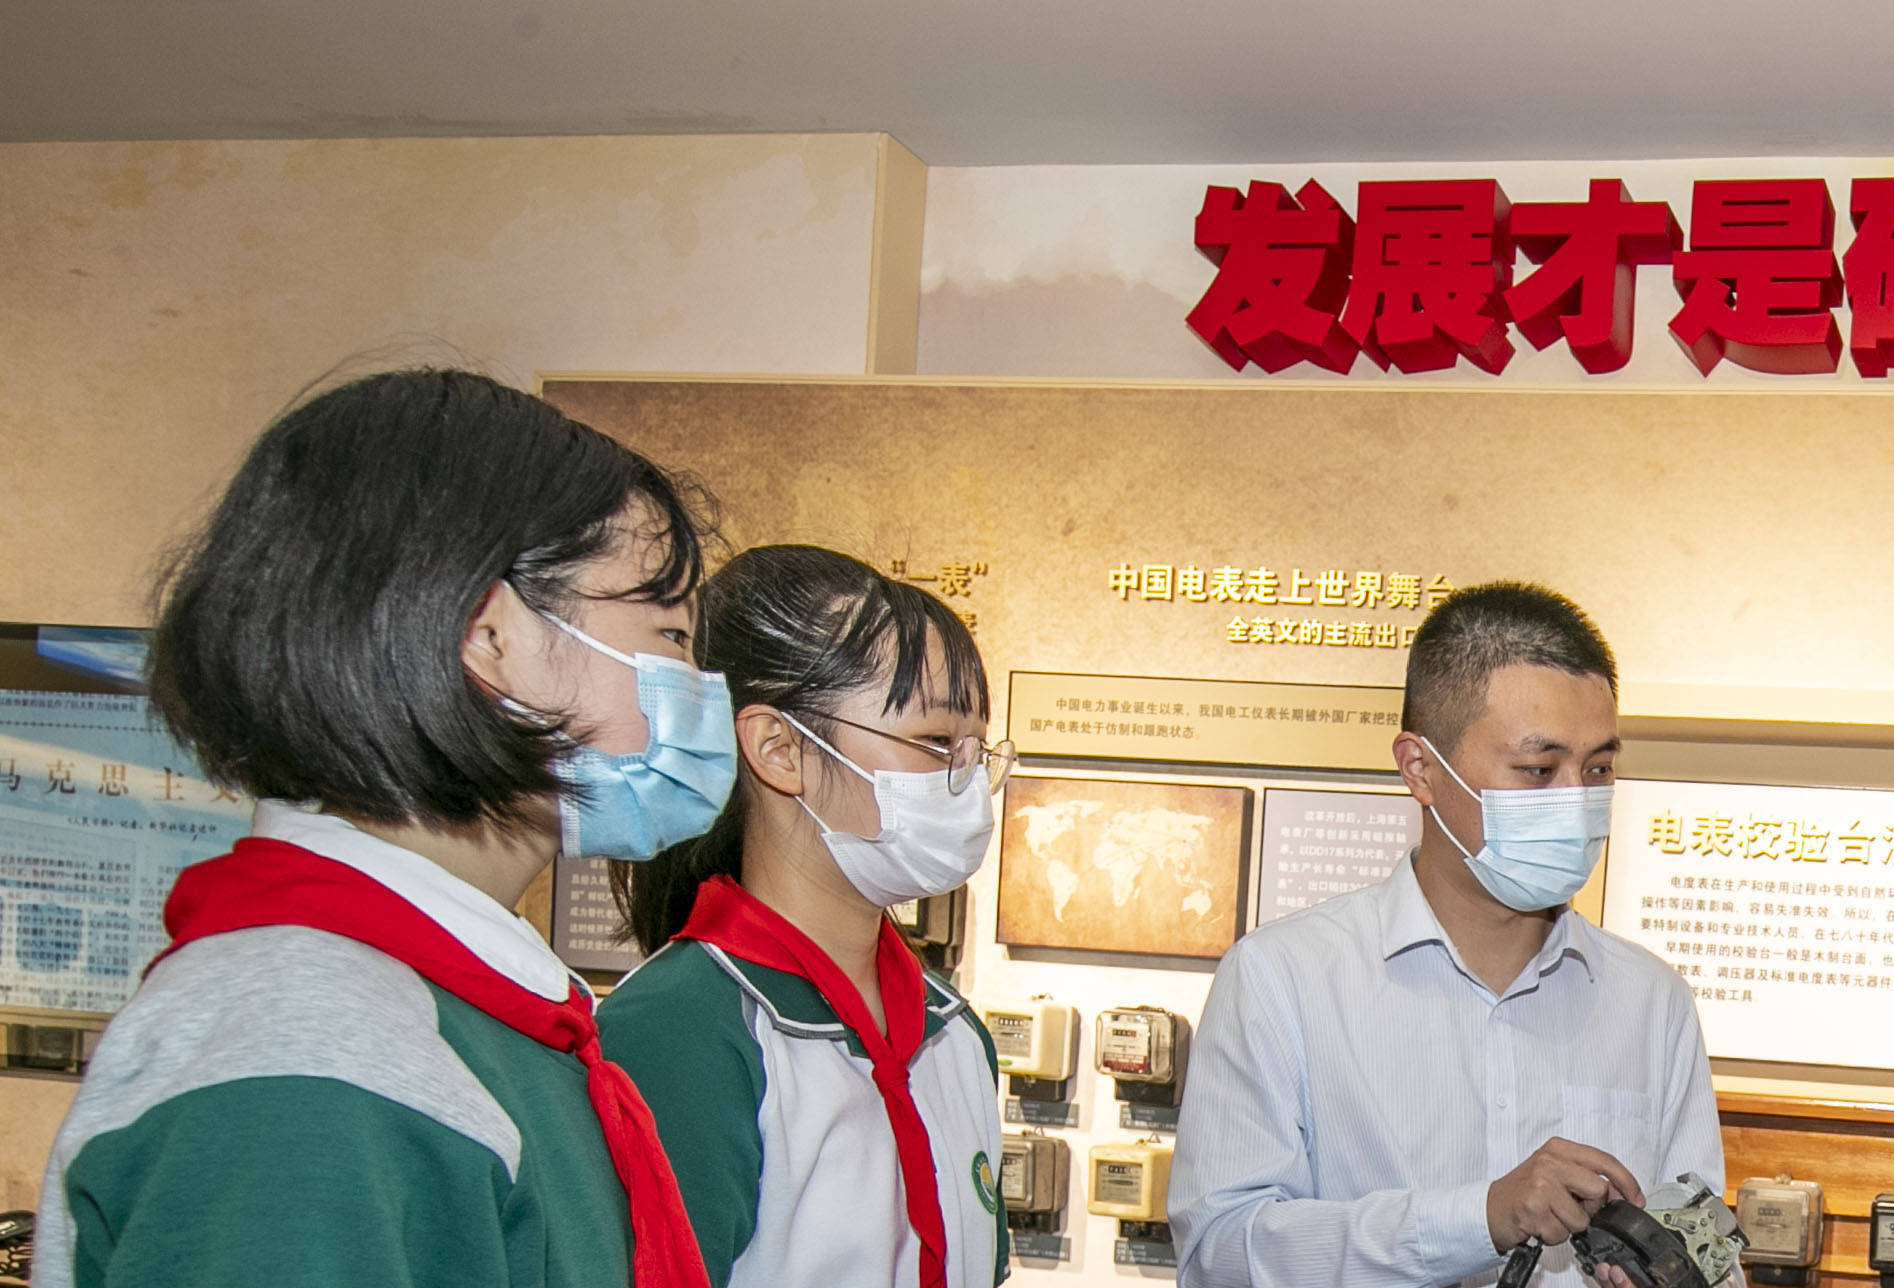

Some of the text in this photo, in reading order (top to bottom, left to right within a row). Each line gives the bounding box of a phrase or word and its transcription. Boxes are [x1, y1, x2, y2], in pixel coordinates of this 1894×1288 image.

[1107, 562, 1455, 611] 中国电表走上世界舞台
